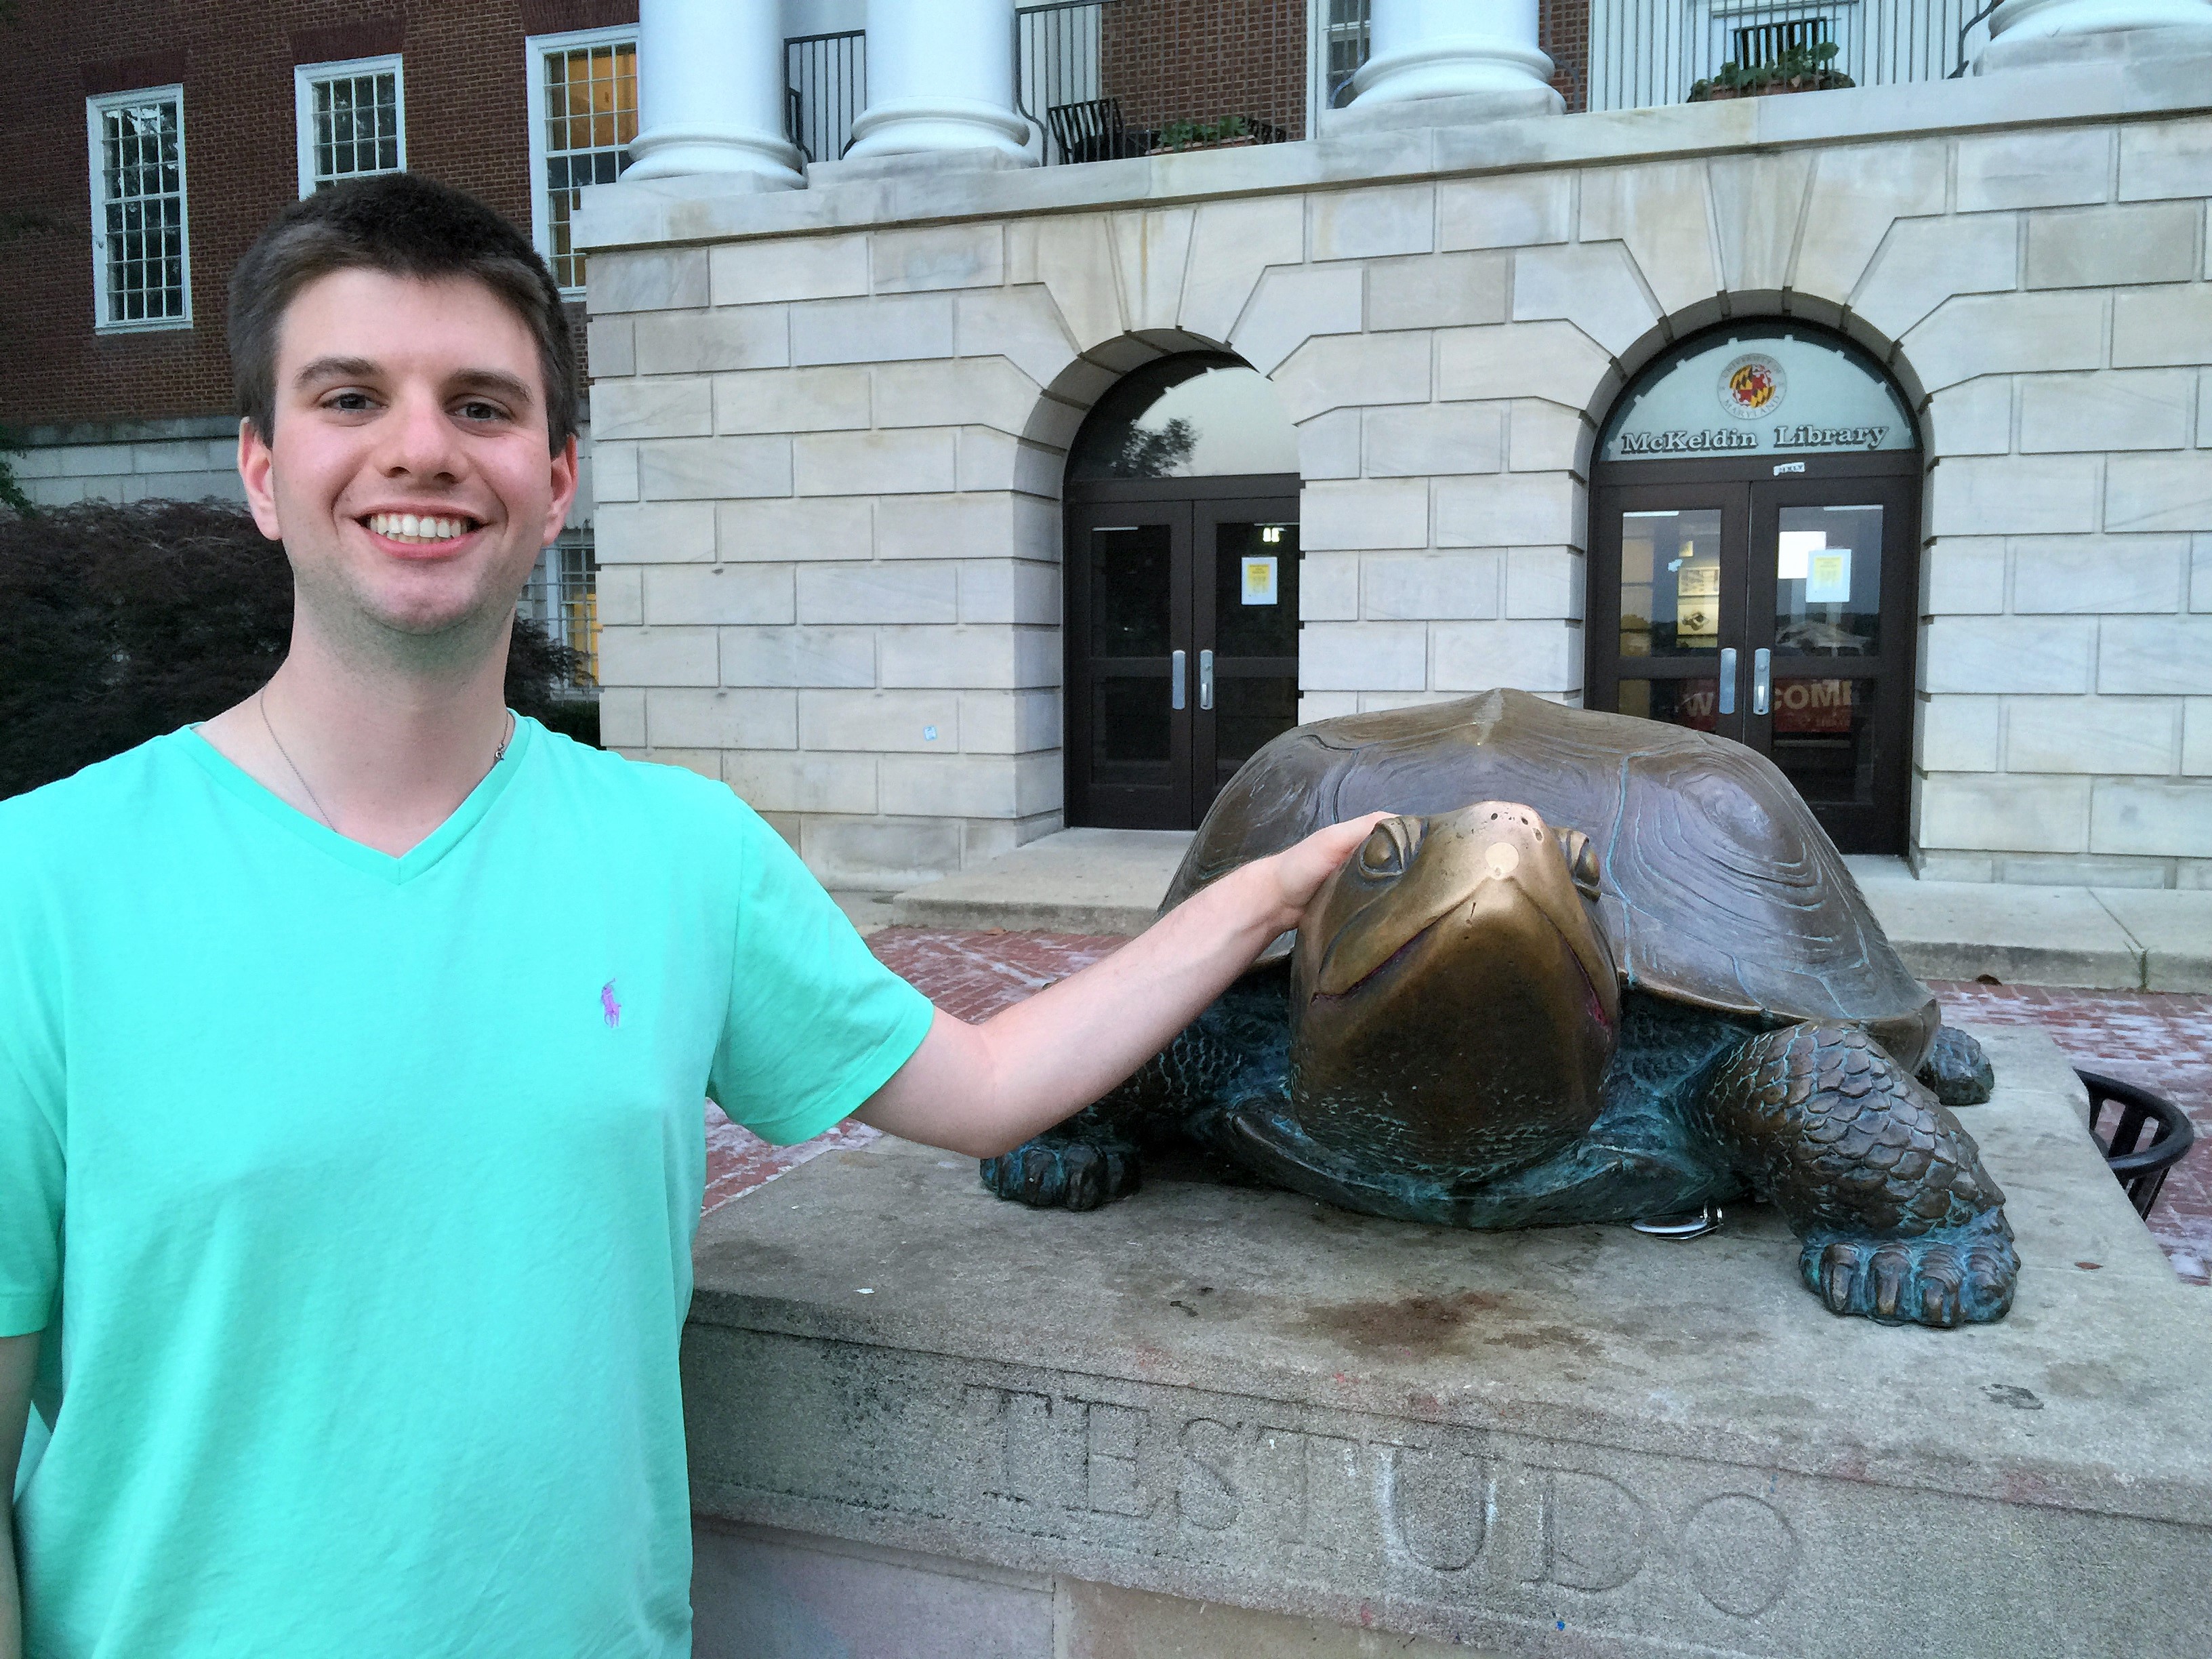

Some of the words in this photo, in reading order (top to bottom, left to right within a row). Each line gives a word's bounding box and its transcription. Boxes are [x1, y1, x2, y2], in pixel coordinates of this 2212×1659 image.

[1621, 428, 1759, 454] McKeldin
[1774, 424, 1889, 451] Library
[959, 1381, 1800, 1622] TESTUDO
